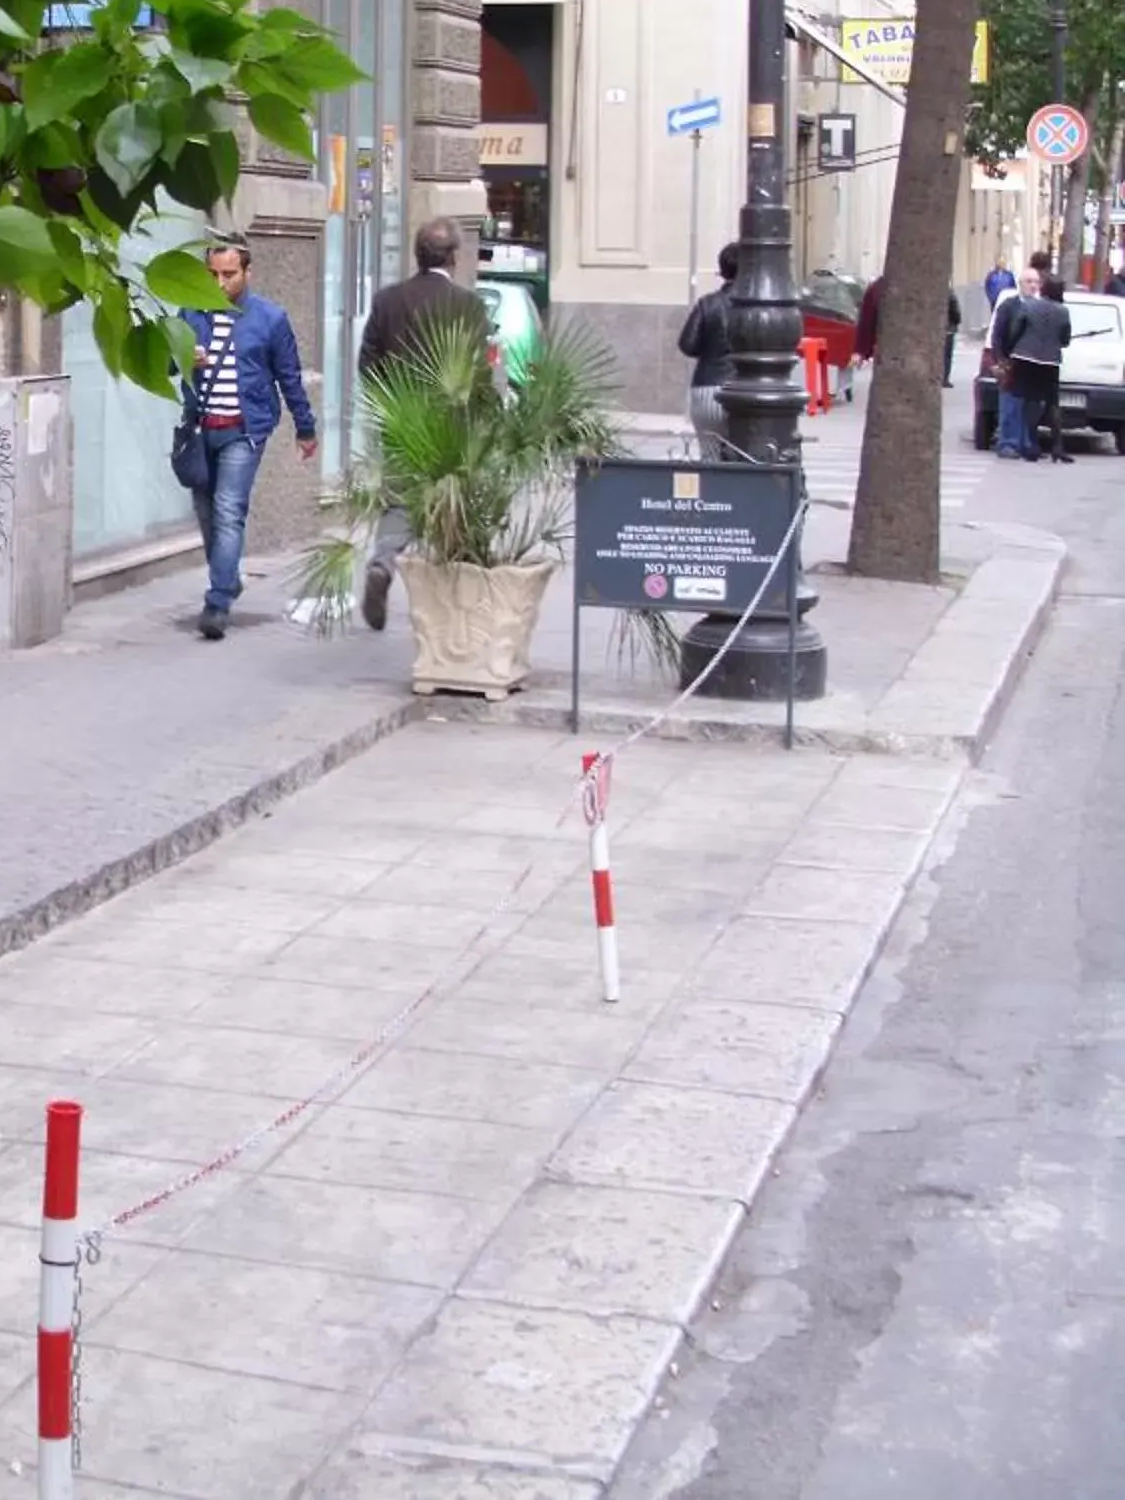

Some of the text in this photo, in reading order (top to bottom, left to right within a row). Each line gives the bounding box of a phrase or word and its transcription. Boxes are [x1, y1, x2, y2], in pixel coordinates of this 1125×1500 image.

[848, 25, 915, 49] TABA
[479, 136, 523, 156] ma
[822, 119, 852, 156] T
[641, 498, 672, 510] Hotel
[675, 499, 692, 511] del
[644, 563, 727, 577] NO PARKING
